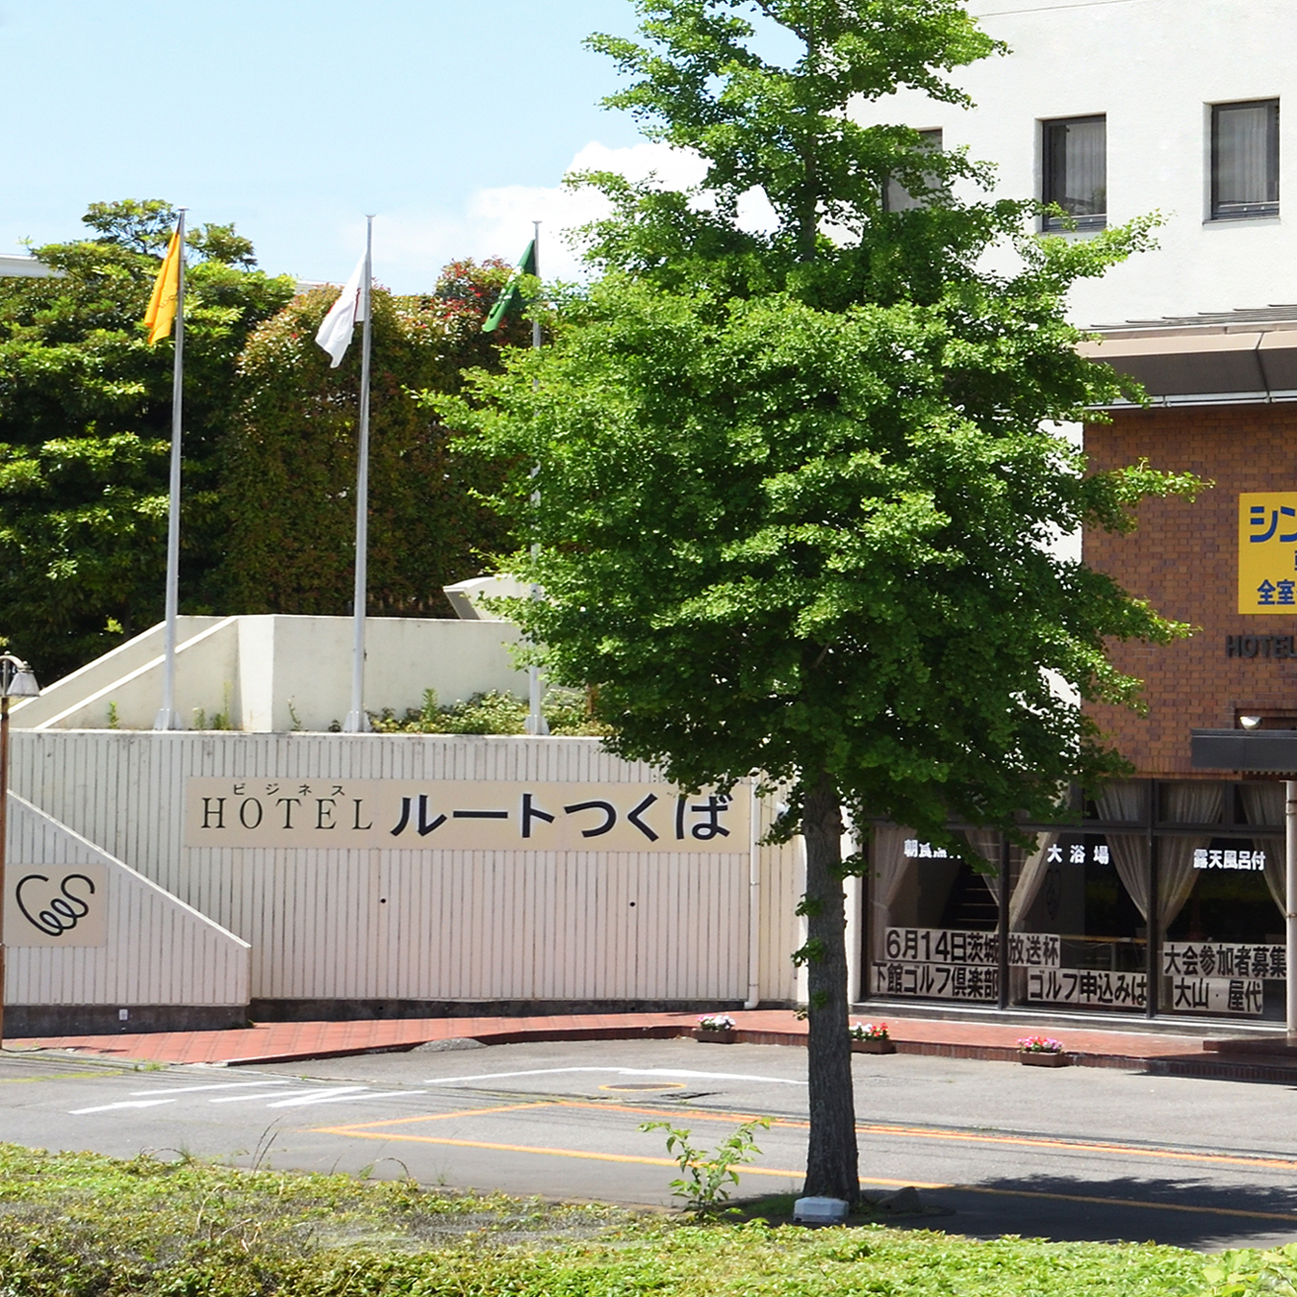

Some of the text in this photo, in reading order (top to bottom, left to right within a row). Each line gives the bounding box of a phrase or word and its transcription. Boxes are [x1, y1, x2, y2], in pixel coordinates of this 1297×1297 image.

[233, 783, 346, 796] ビジネス
[201, 793, 733, 842] HOTEL ルートつくば
[1047, 844, 1110, 864] 大浴場
[1193, 848, 1266, 870] 露天風呂付
[872, 961, 998, 999] 下館ゴルフ倶楽部
